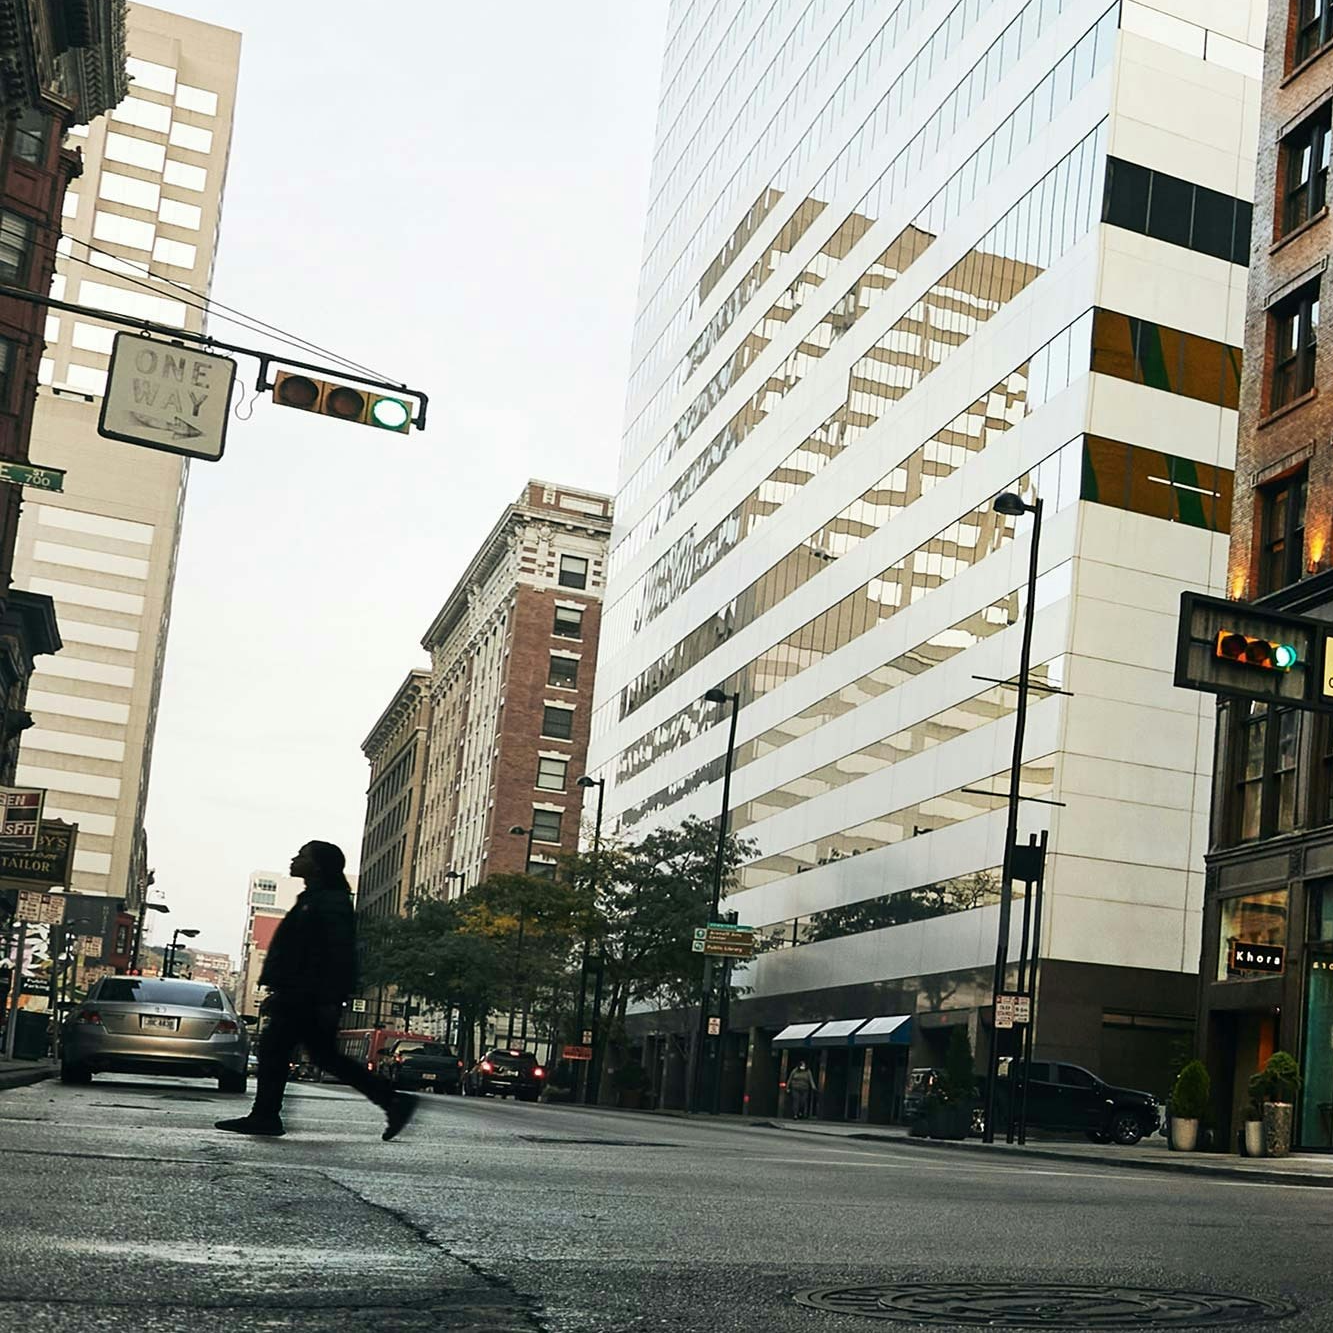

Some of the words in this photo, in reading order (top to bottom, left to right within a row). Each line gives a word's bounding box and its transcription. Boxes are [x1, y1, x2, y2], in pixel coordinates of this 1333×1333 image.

[135, 348, 212, 390] ONE
[132, 377, 209, 417] WAY
[24, 474, 50, 486] 700
[1236, 951, 1280, 965] Khora
